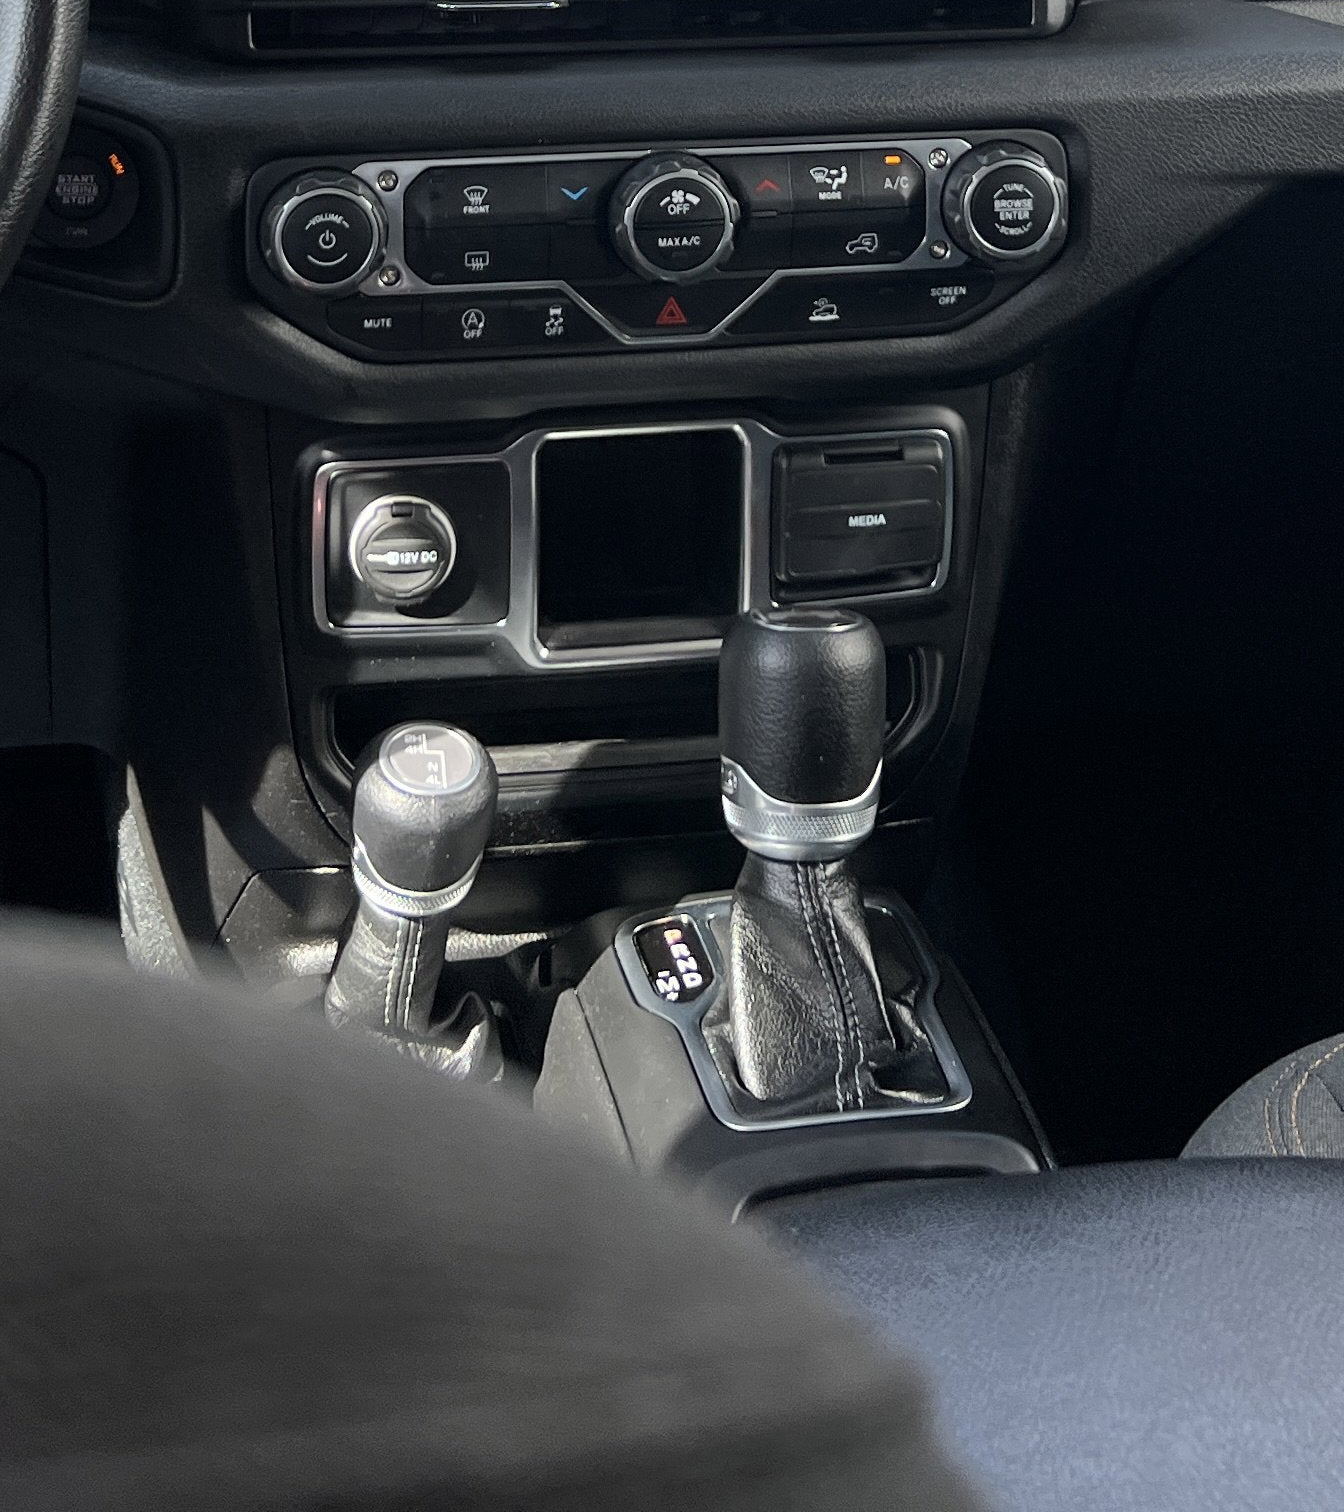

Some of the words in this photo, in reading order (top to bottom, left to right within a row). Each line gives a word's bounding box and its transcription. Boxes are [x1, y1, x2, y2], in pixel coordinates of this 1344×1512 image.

[884, 175, 910, 190] A/C
[1002, 183, 1025, 193] TUNE
[818, 190, 843, 201] MODE
[463, 204, 491, 215] FRONT
[667, 202, 691, 216] OFF
[994, 199, 1034, 210] BROWSE
[311, 212, 344, 226] VOLUME
[999, 210, 1031, 221] ENTER
[997, 224, 1029, 236] SCROLL
[658, 236, 680, 248] MAX
[681, 235, 701, 247] A/C
[930, 285, 967, 298] SCREEN
[938, 295, 957, 306] OFF
[363, 316, 392, 329] MUTE
[463, 328, 483, 339] OFF
[545, 326, 564, 337] OFF
[848, 513, 887, 527] MEDIA
[399, 551, 420, 565] 12V
[420, 550, 438, 564] DC
[427, 761, 439, 773] N
[425, 774, 442, 786] 4L
[670, 942, 691, 960] R
[676, 956, 698, 974] N
[656, 975, 680, 995] M
[682, 972, 703, 989] D
